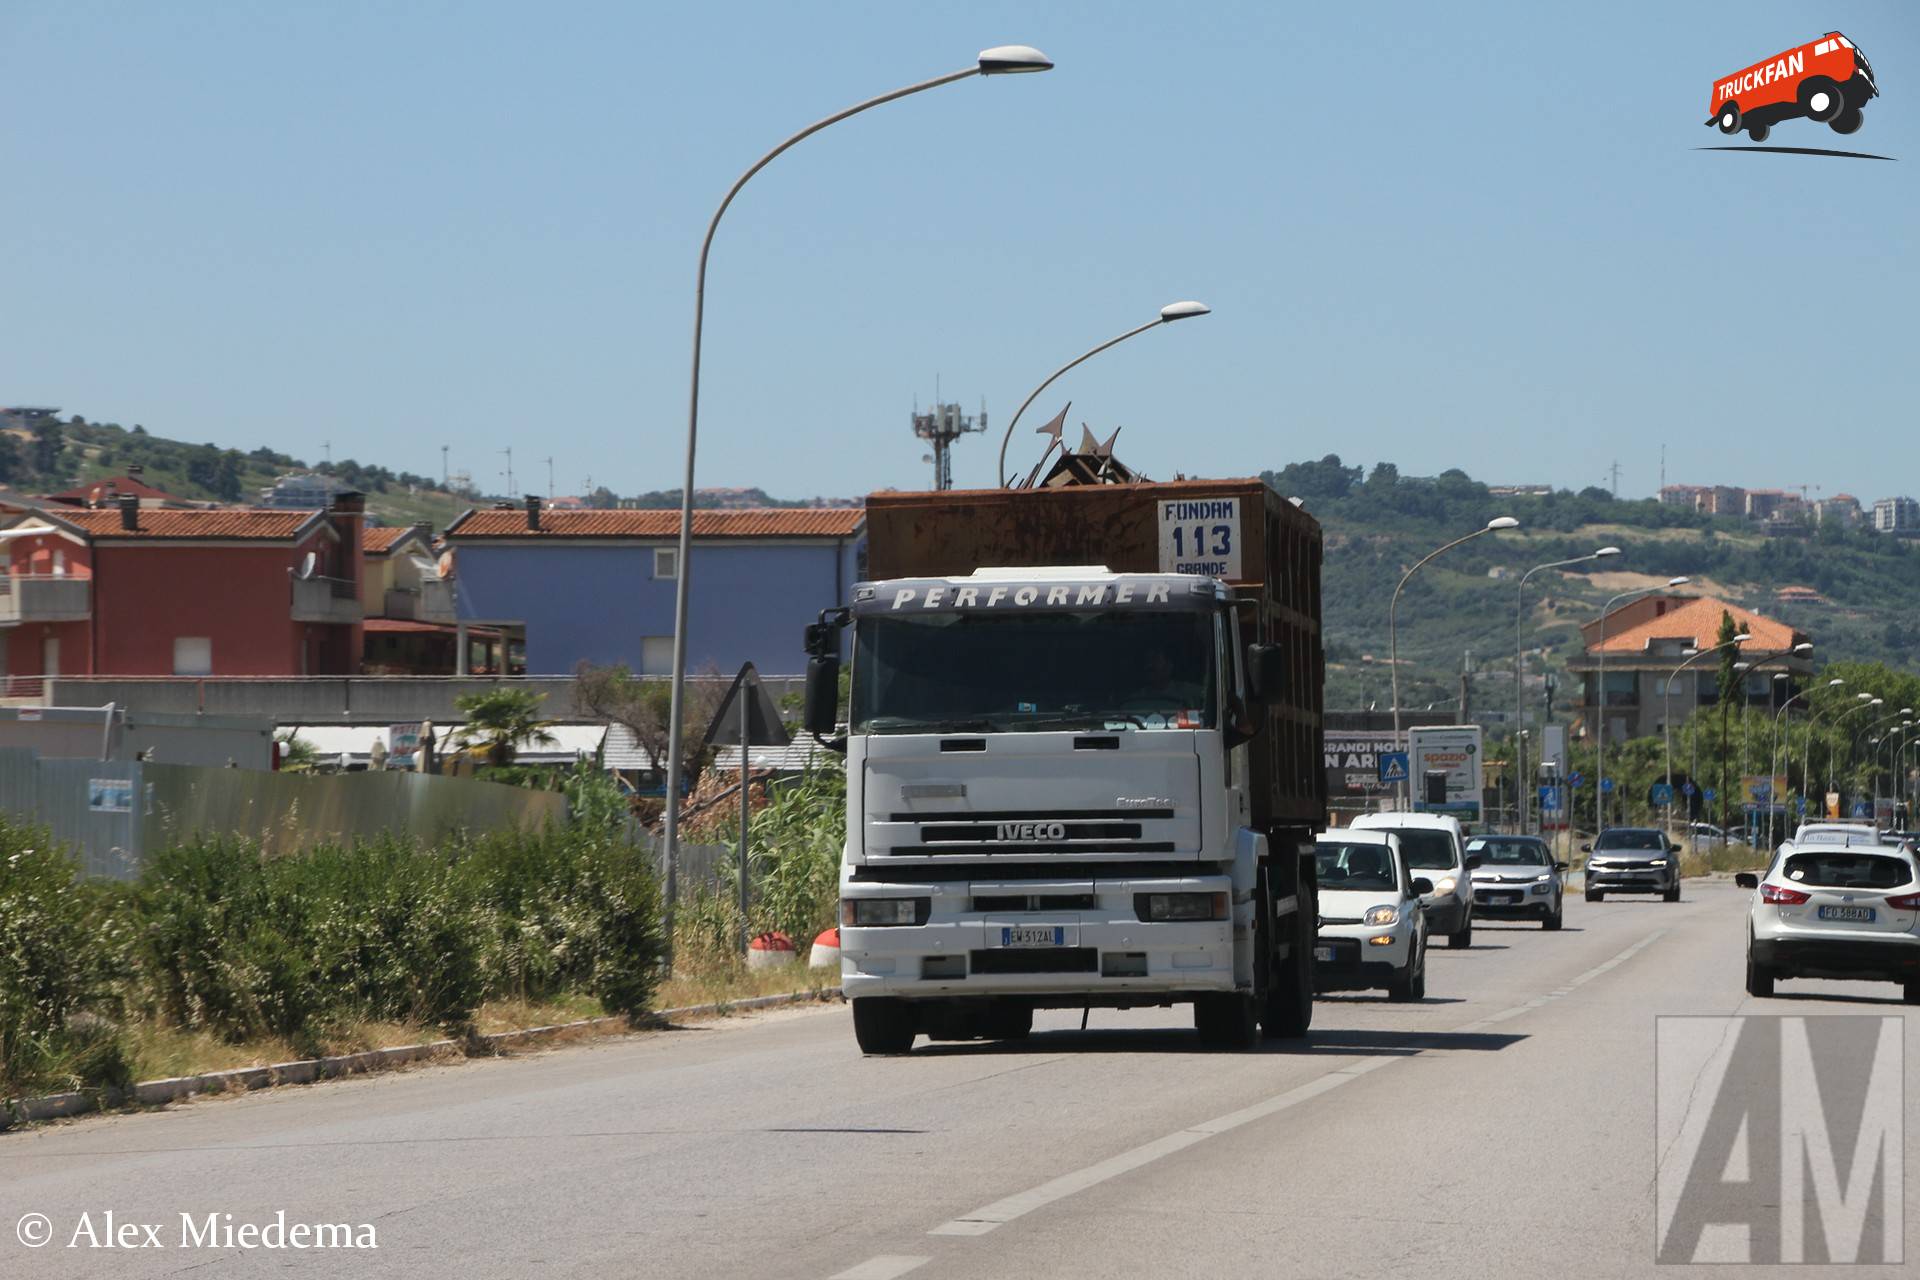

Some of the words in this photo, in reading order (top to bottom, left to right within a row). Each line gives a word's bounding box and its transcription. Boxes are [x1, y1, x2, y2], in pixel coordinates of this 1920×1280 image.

[1173, 525, 1231, 557] 113
[1177, 562, 1227, 575] GRANDE
[892, 582, 1171, 609] PERFORMER
[997, 823, 1066, 840] IVECO
